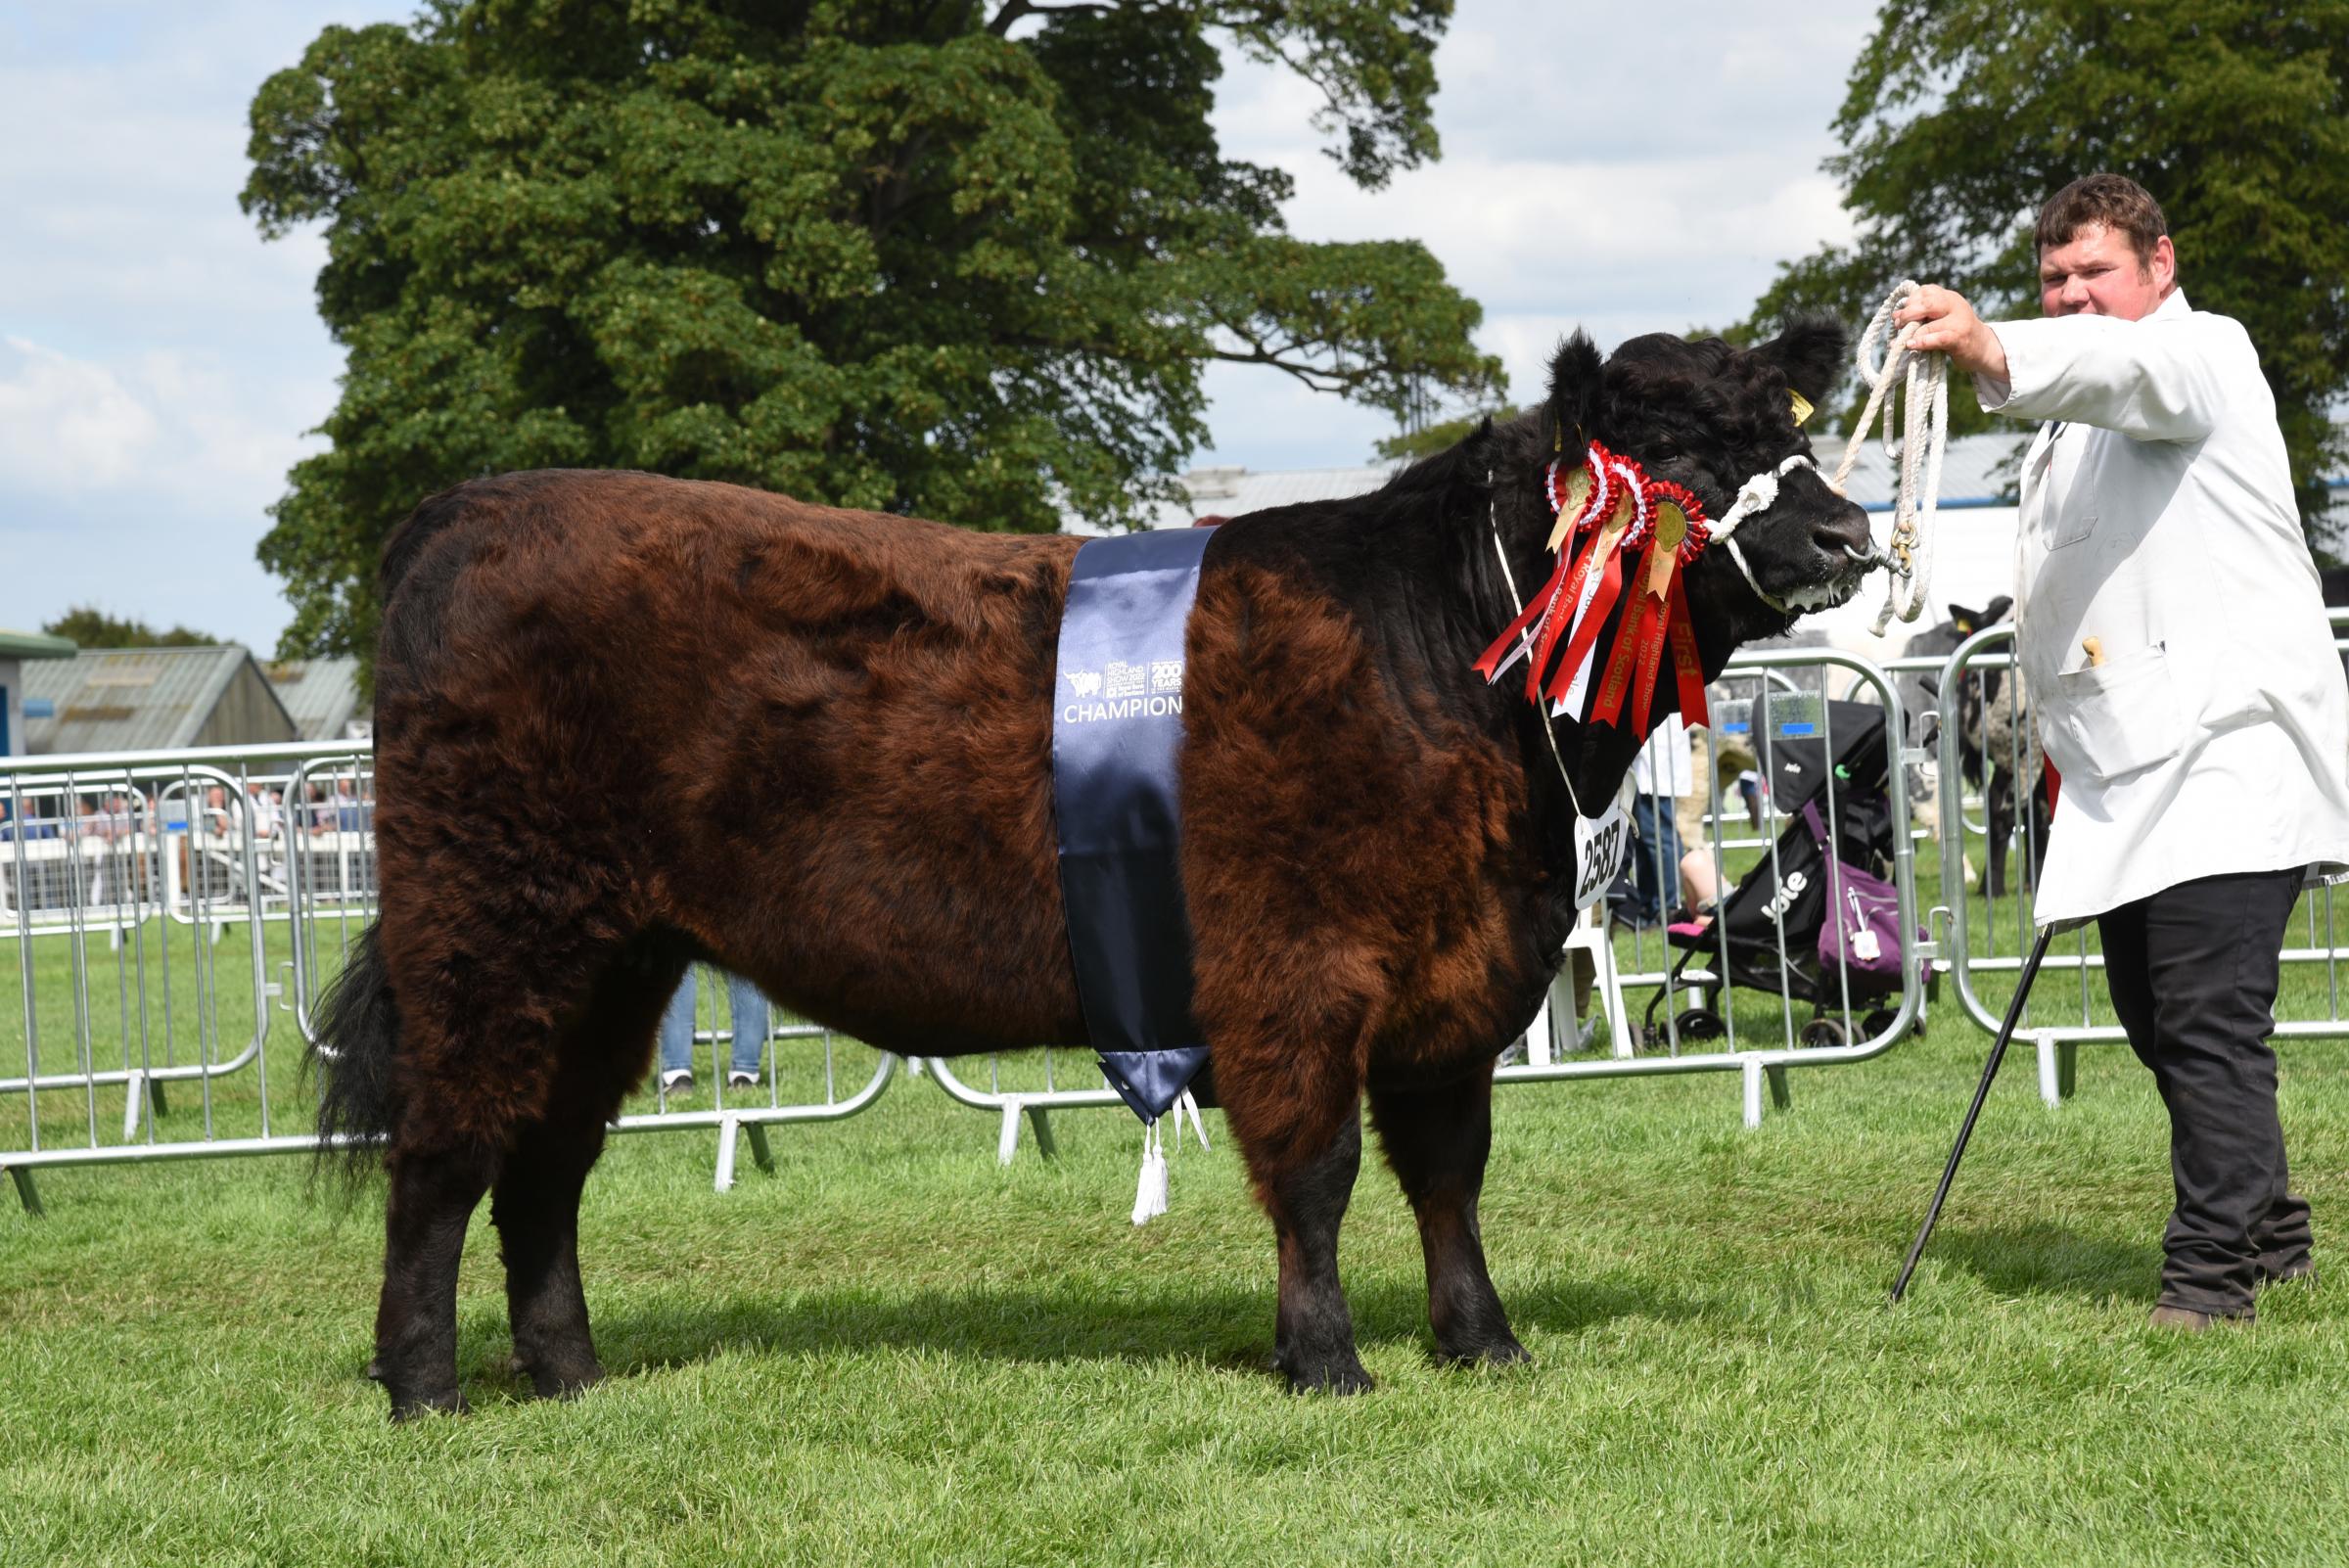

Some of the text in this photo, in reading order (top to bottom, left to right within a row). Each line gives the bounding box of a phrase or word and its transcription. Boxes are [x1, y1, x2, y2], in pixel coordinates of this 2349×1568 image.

[1628, 603, 1646, 636] Bank
[1656, 602, 1670, 631] Royal
[1621, 636, 1634, 653] of
[1647, 632, 1664, 679] Highland
[1674, 623, 1697, 676] First
[1152, 664, 1181, 679] 200
[1152, 677, 1181, 687] YEARS
[1604, 653, 1631, 708] Scotland
[1063, 696, 1182, 723] CHAMPION
[1578, 818, 1620, 899] 2587
